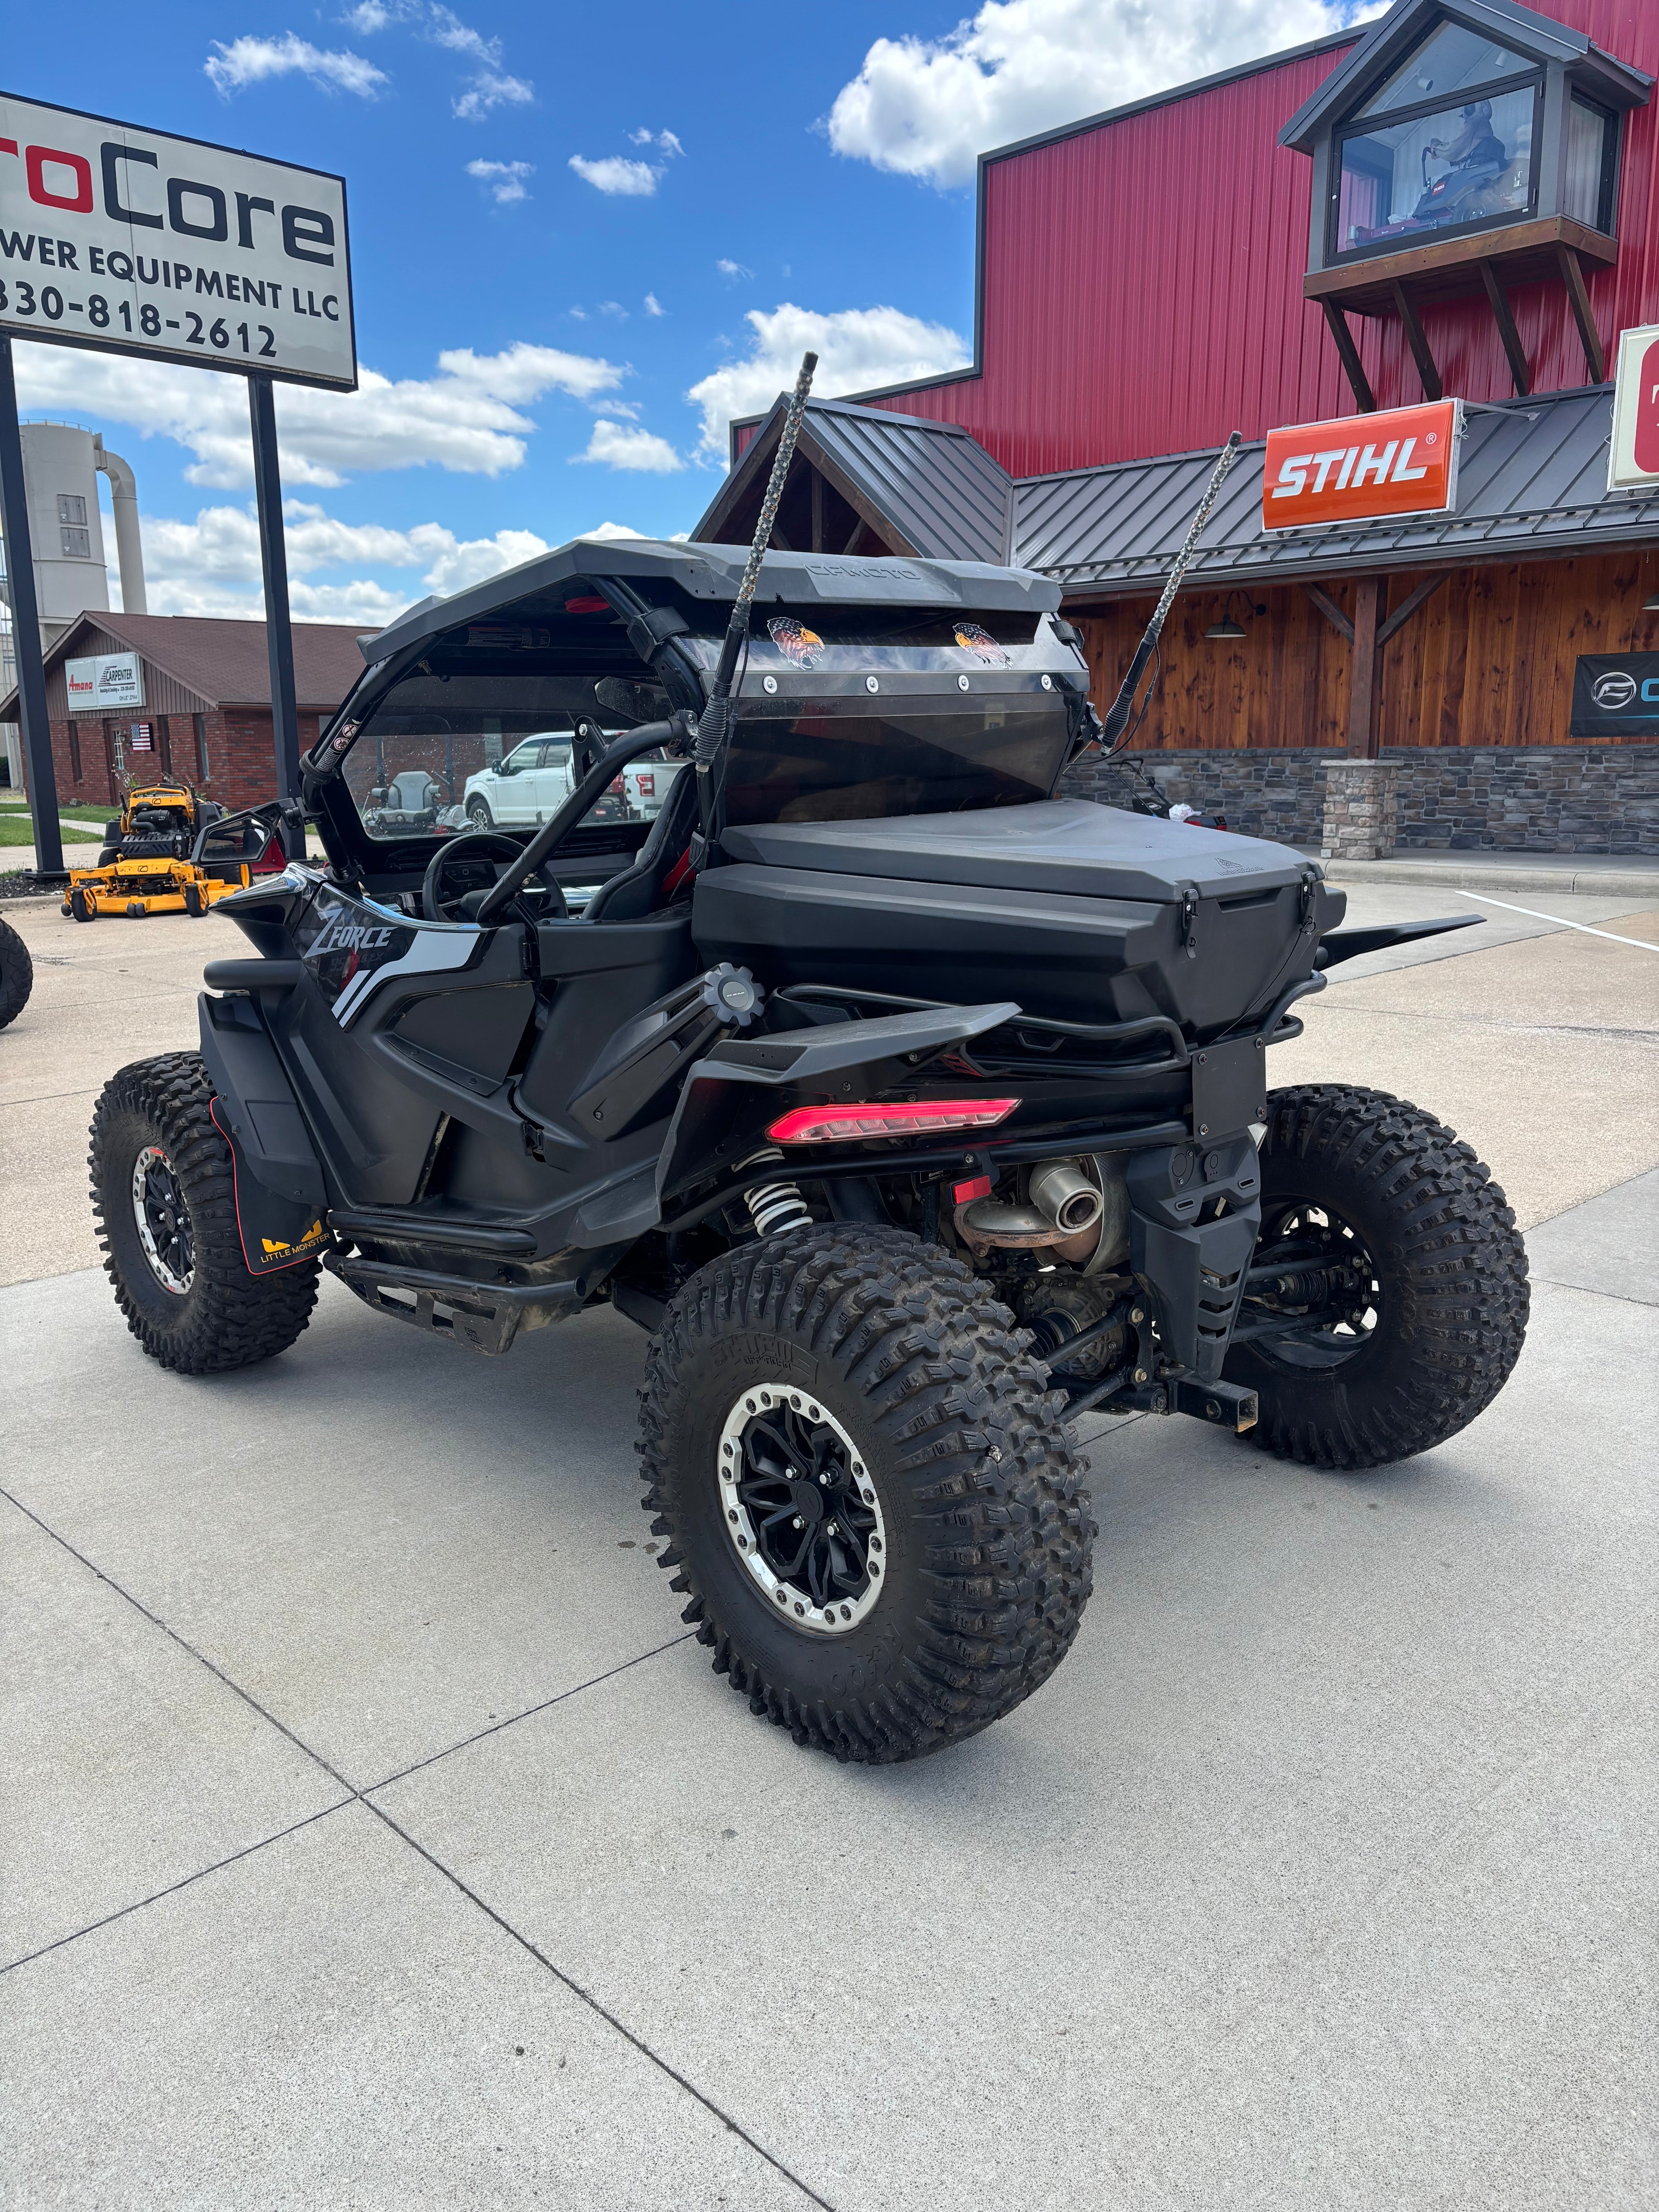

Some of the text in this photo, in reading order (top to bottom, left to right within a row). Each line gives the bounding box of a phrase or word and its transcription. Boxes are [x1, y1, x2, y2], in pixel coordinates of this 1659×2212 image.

[89, 246, 282, 309] EQUIPMENT
[293, 287, 339, 321] LLC
[1271, 437, 1428, 498] STIHL
[804, 564, 921, 580] CFMOTO
[69, 674, 93, 691] Amana
[106, 668, 132, 682] CARPENTER
[260, 1233, 330, 1263] LITTLE MONSTER
